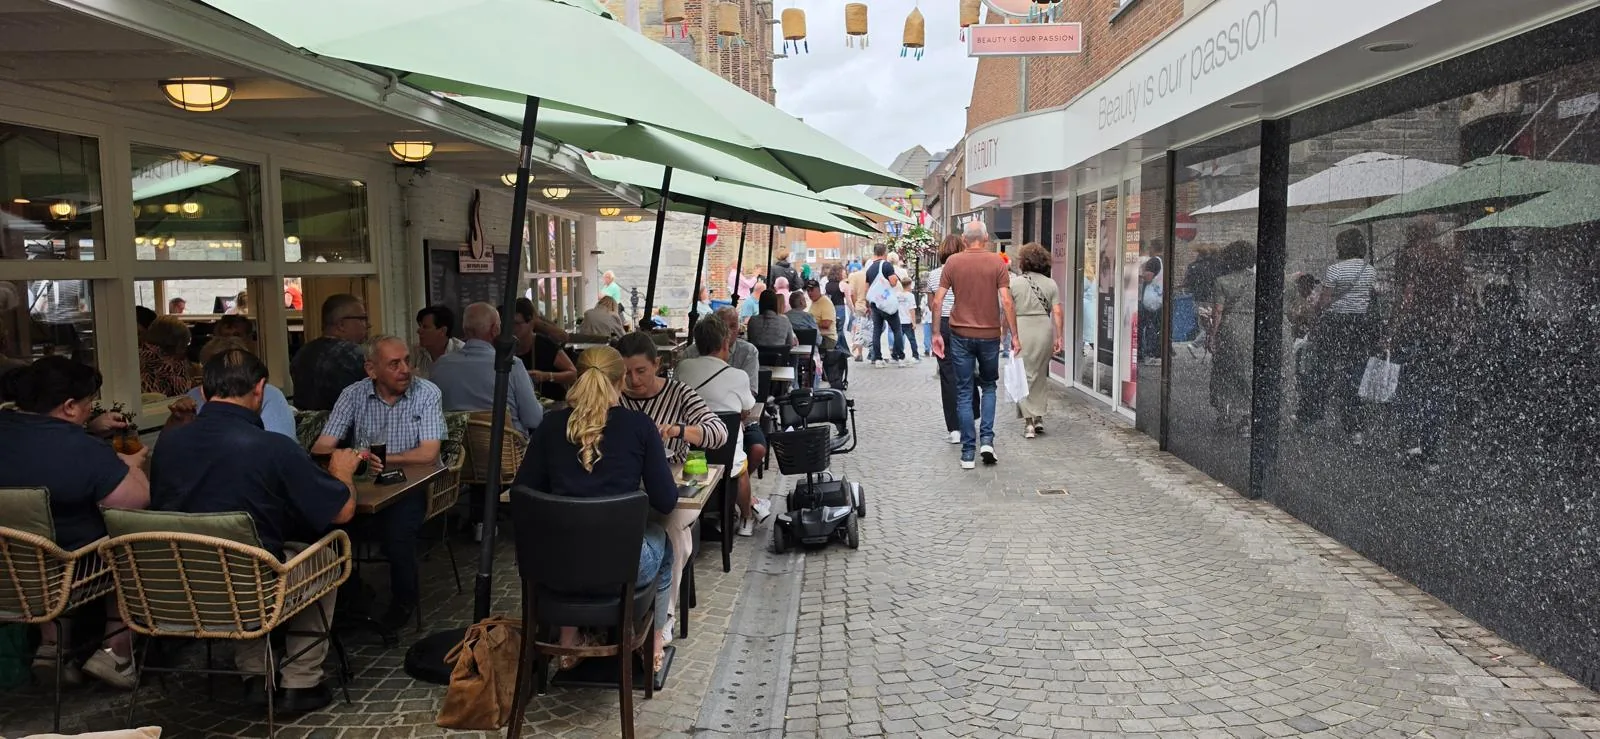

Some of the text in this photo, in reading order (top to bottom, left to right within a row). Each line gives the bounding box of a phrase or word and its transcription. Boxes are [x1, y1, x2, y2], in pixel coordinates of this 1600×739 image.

[977, 36, 1007, 44] BEAUTY
[1019, 35, 1036, 43] OUR
[1038, 34, 1074, 42] PASSION
[1098, 0, 1278, 130] Beauty is our passion
